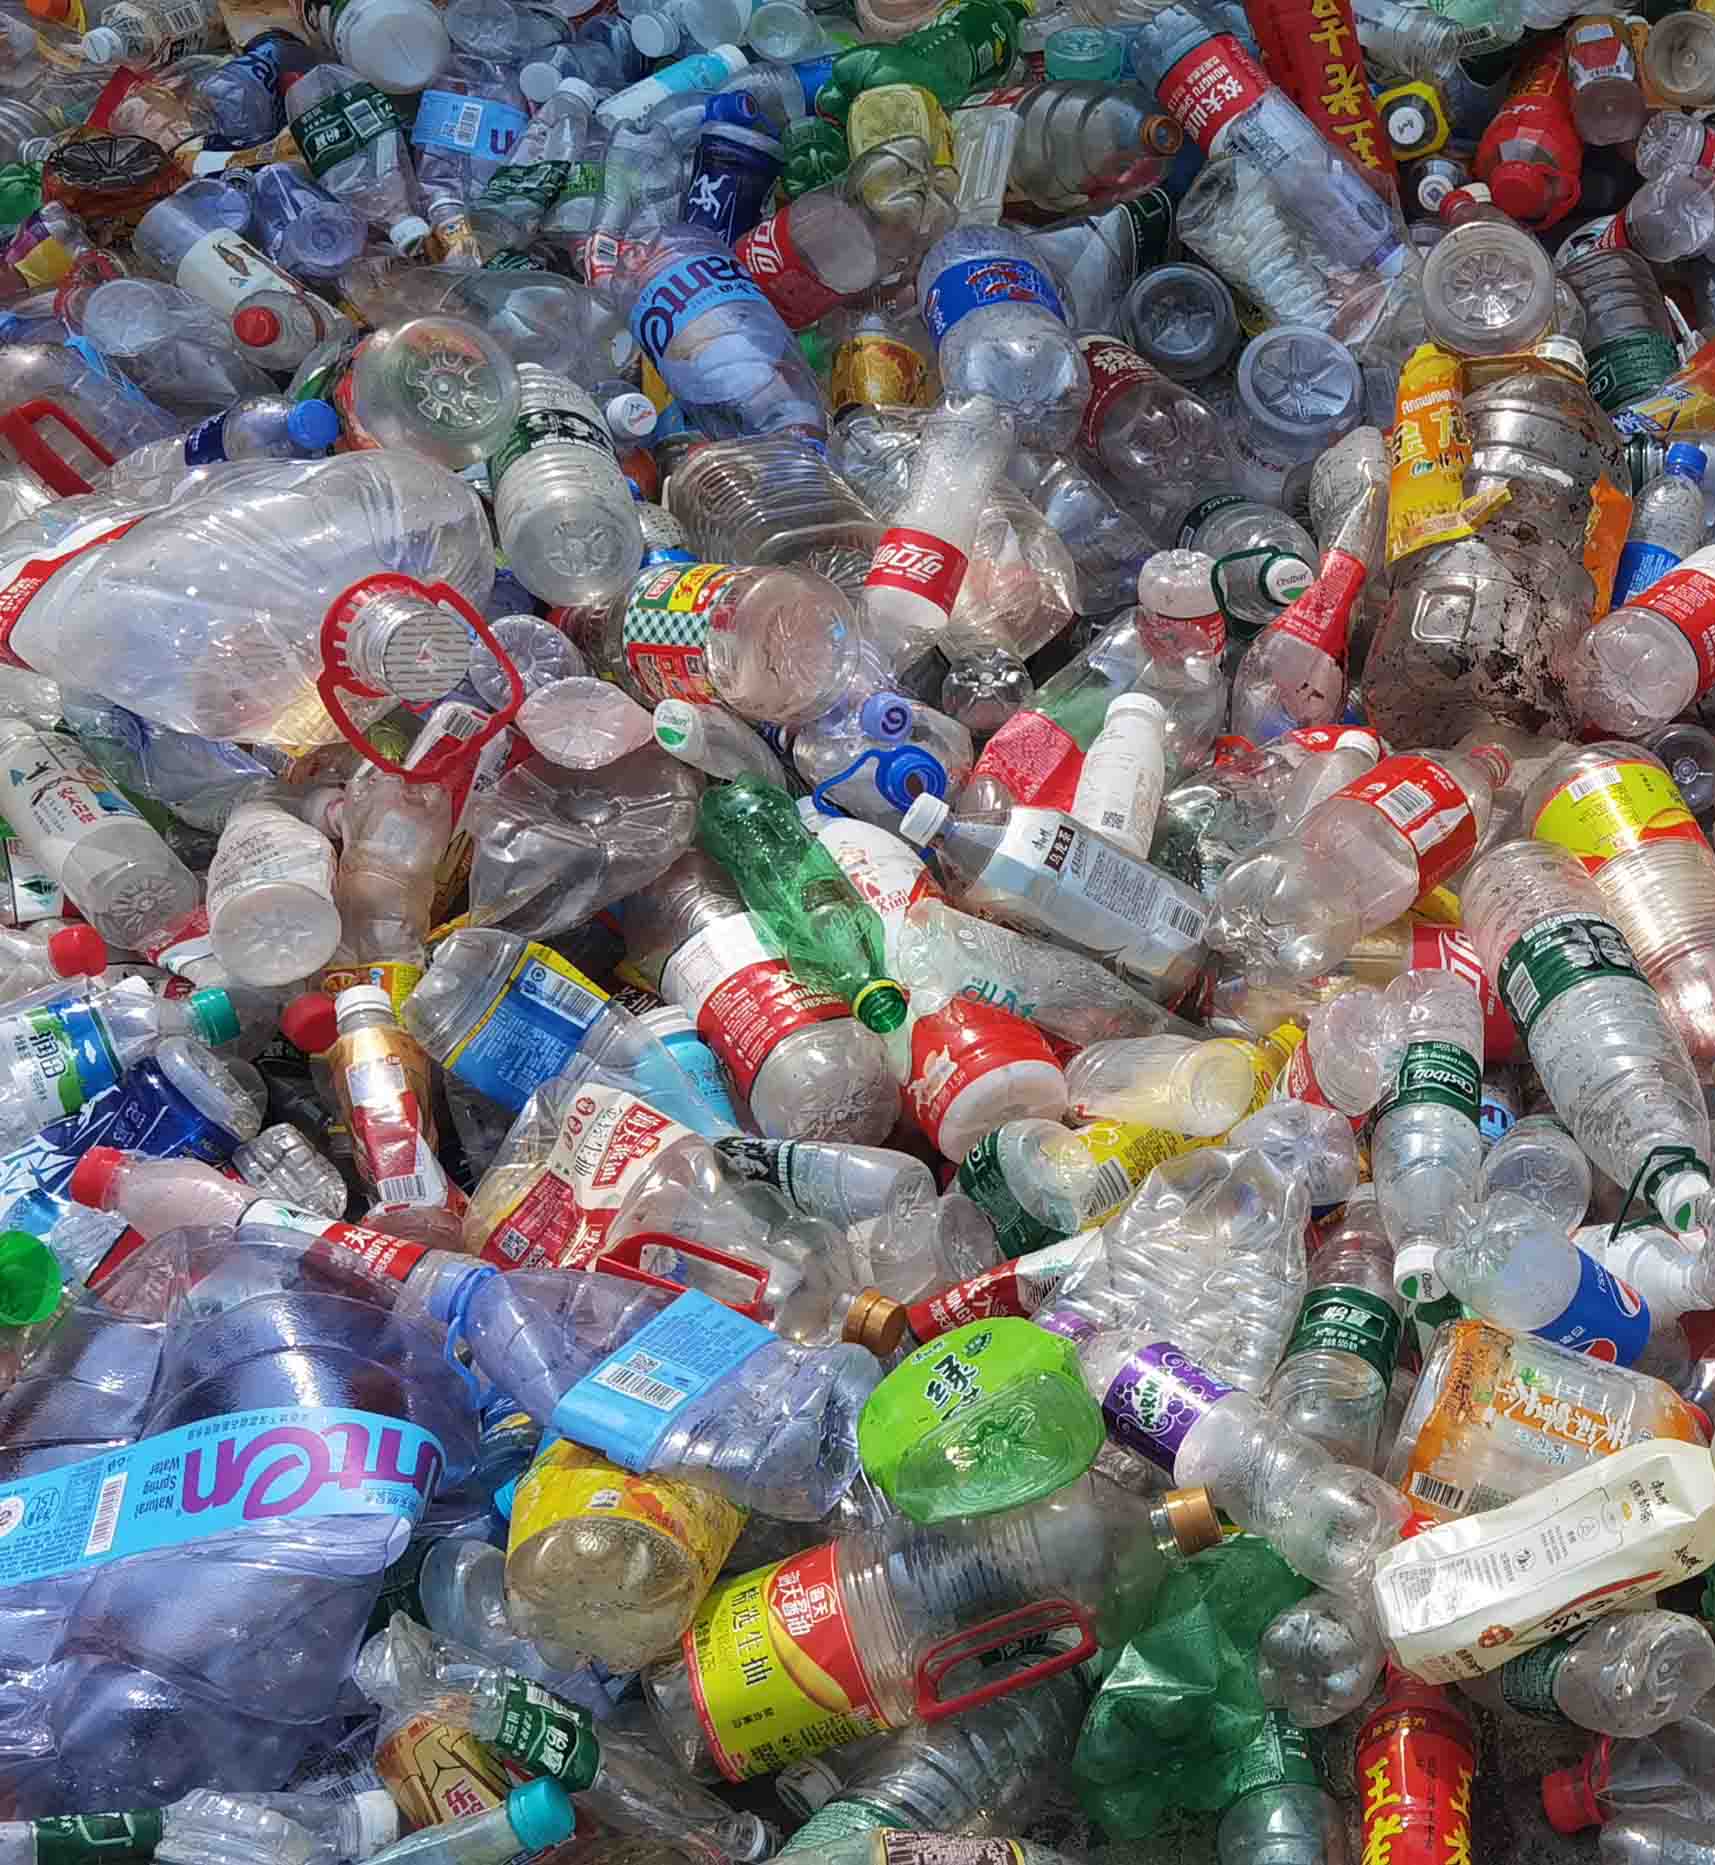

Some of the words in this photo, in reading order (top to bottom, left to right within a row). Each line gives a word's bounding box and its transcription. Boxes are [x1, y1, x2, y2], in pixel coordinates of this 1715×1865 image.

[1309, 0, 1385, 172] 王老吉
[638, 254, 752, 360] ante
[31, 1030, 68, 1080] 润田
[1319, 1303, 1371, 1327] 怡宝
[1139, 1376, 1163, 1430] MIRIN
[142, 1472, 177, 1494] Spring
[149, 1454, 181, 1476] Water
[180, 1420, 440, 1513] nten
[134, 1496, 176, 1520] Natural
[731, 1584, 773, 1687] 精选生抽
[539, 1723, 570, 1775] 怡宝
